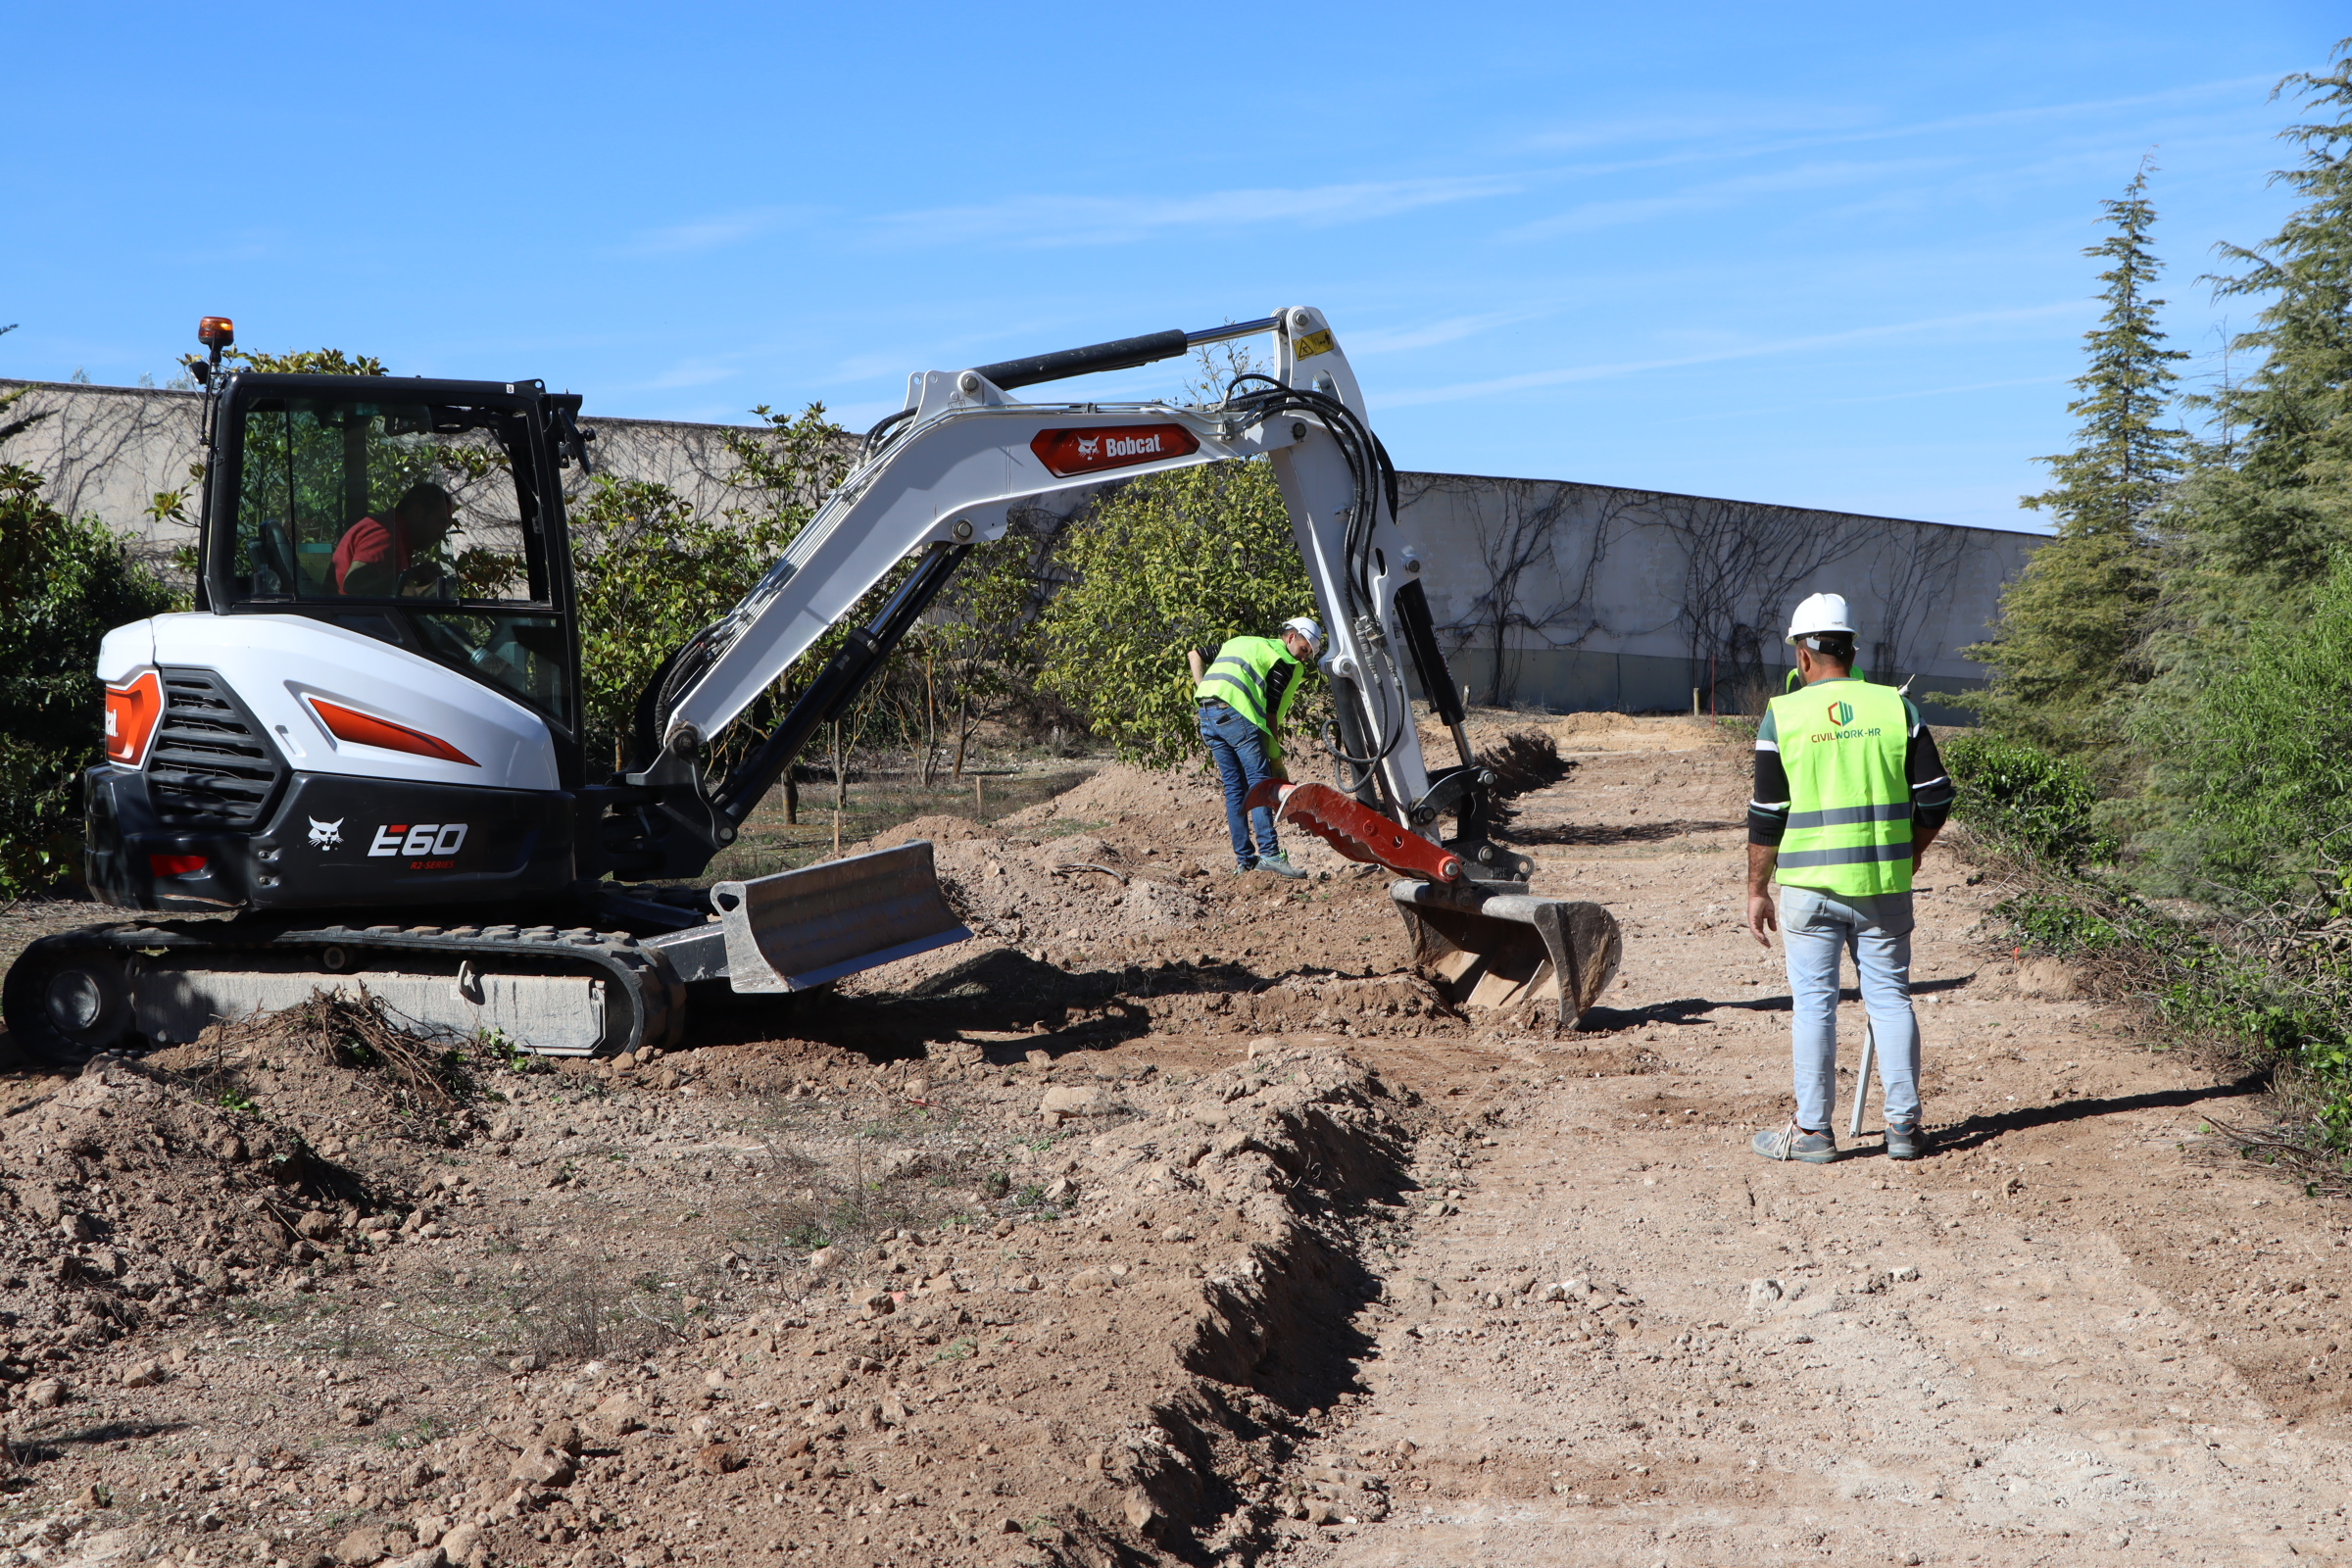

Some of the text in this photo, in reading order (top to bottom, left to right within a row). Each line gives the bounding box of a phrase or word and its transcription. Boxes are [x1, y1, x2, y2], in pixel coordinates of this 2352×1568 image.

[1105, 434, 1160, 457] Bobcat
[1811, 728, 1882, 743] CIVILWORK-HR
[368, 823, 468, 857] E60
[410, 860, 456, 870] R2-SERIES
